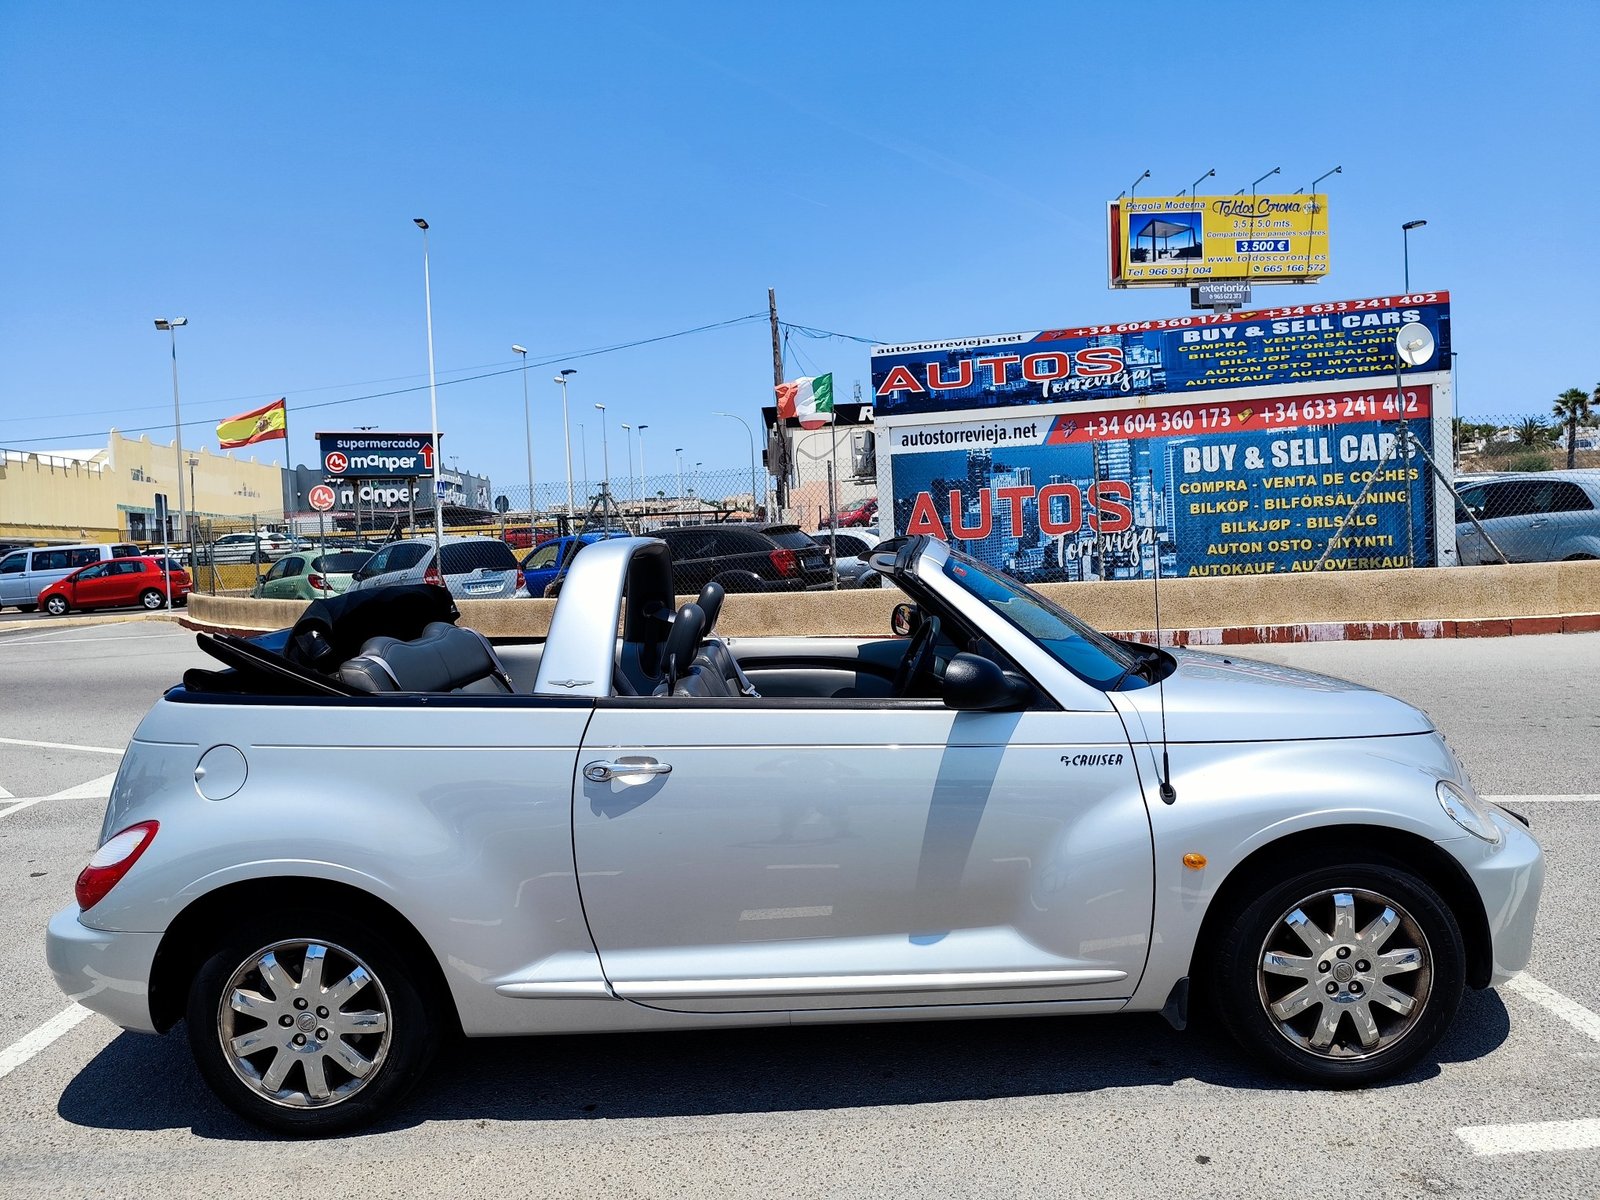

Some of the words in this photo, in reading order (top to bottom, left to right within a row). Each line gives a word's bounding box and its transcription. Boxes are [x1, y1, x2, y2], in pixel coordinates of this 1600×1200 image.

[1165, 200, 1206, 209] Moderna
[1257, 198, 1301, 214] Corona
[1206, 231, 1249, 239] Compatible
[1267, 230, 1296, 238] paneles
[1240, 241, 1274, 252] 3.500
[1277, 241, 1286, 251] €
[1207, 253, 1326, 263] www.toldoscorona.es
[1128, 268, 1145, 276] Tel.
[1148, 268, 1168, 276] 966
[1170, 267, 1189, 275] 931
[1192, 267, 1212, 275] 004
[1263, 265, 1282, 273] 665
[1286, 264, 1304, 272] 166
[1264, 306, 1305, 319] +34
[1311, 302, 1347, 314] 633
[1355, 299, 1391, 309] 241
[1398, 294, 1438, 305] 402
[1073, 325, 1111, 337] +34
[1117, 321, 1151, 333] 604
[1156, 317, 1189, 328] 360
[1198, 313, 1233, 325] 173
[1183, 327, 1237, 343] BUY
[1245, 325, 1265, 337] &
[1272, 318, 1334, 335] SELL
[1342, 309, 1421, 327] CARS
[876, 335, 1023, 355] autostorrevieja.net
[1178, 340, 1247, 352] COMPRA
[1262, 332, 1318, 344] VENTA
[1324, 331, 1345, 339] DE
[1352, 327, 1400, 336] COCH
[1188, 349, 1248, 359] BILKÖP
[1263, 336, 1398, 353] BILFÖRSÄLJNIN
[1306, 346, 1379, 358] BILSALG
[876, 347, 1125, 396] AUTOS
[1205, 364, 1261, 375] AUTON
[1267, 361, 1312, 370] OSTO
[1328, 354, 1395, 366] MYYNTI
[1037, 369, 1150, 398] Torrevieja
[1185, 374, 1274, 387] AUTOKAUF
[1260, 401, 1298, 424] +34
[1302, 399, 1337, 420] 633
[1343, 395, 1375, 417] 241
[1382, 392, 1418, 414] 402
[1083, 418, 1120, 436] +34
[1123, 415, 1156, 433] 604
[1161, 409, 1194, 431] 360
[1199, 407, 1231, 427] 173
[337, 438, 420, 450] supermercado
[901, 423, 1037, 447] autostorrevieja.net
[1183, 444, 1237, 474] BUY
[1244, 446, 1264, 470] &
[1271, 437, 1332, 467] SELL
[1340, 431, 1416, 463] CARS
[351, 454, 417, 472] manper
[1179, 480, 1247, 495] COMPRA
[1263, 474, 1317, 489] VENTA
[1323, 473, 1344, 485] DE
[1350, 468, 1419, 484] COCHES
[341, 486, 420, 507] manper
[905, 479, 1134, 542] AUTOS
[1190, 500, 1249, 515] BILKÖP
[1221, 519, 1291, 534] BILKJØP
[1306, 514, 1377, 528] BILSALG
[1207, 542, 1263, 555] AUTON
[1268, 539, 1313, 552] OSTO
[1328, 535, 1393, 549] MYYNTI
[1188, 563, 1274, 577] AUTOKAUF
[1072, 754, 1123, 766] CRUISER
